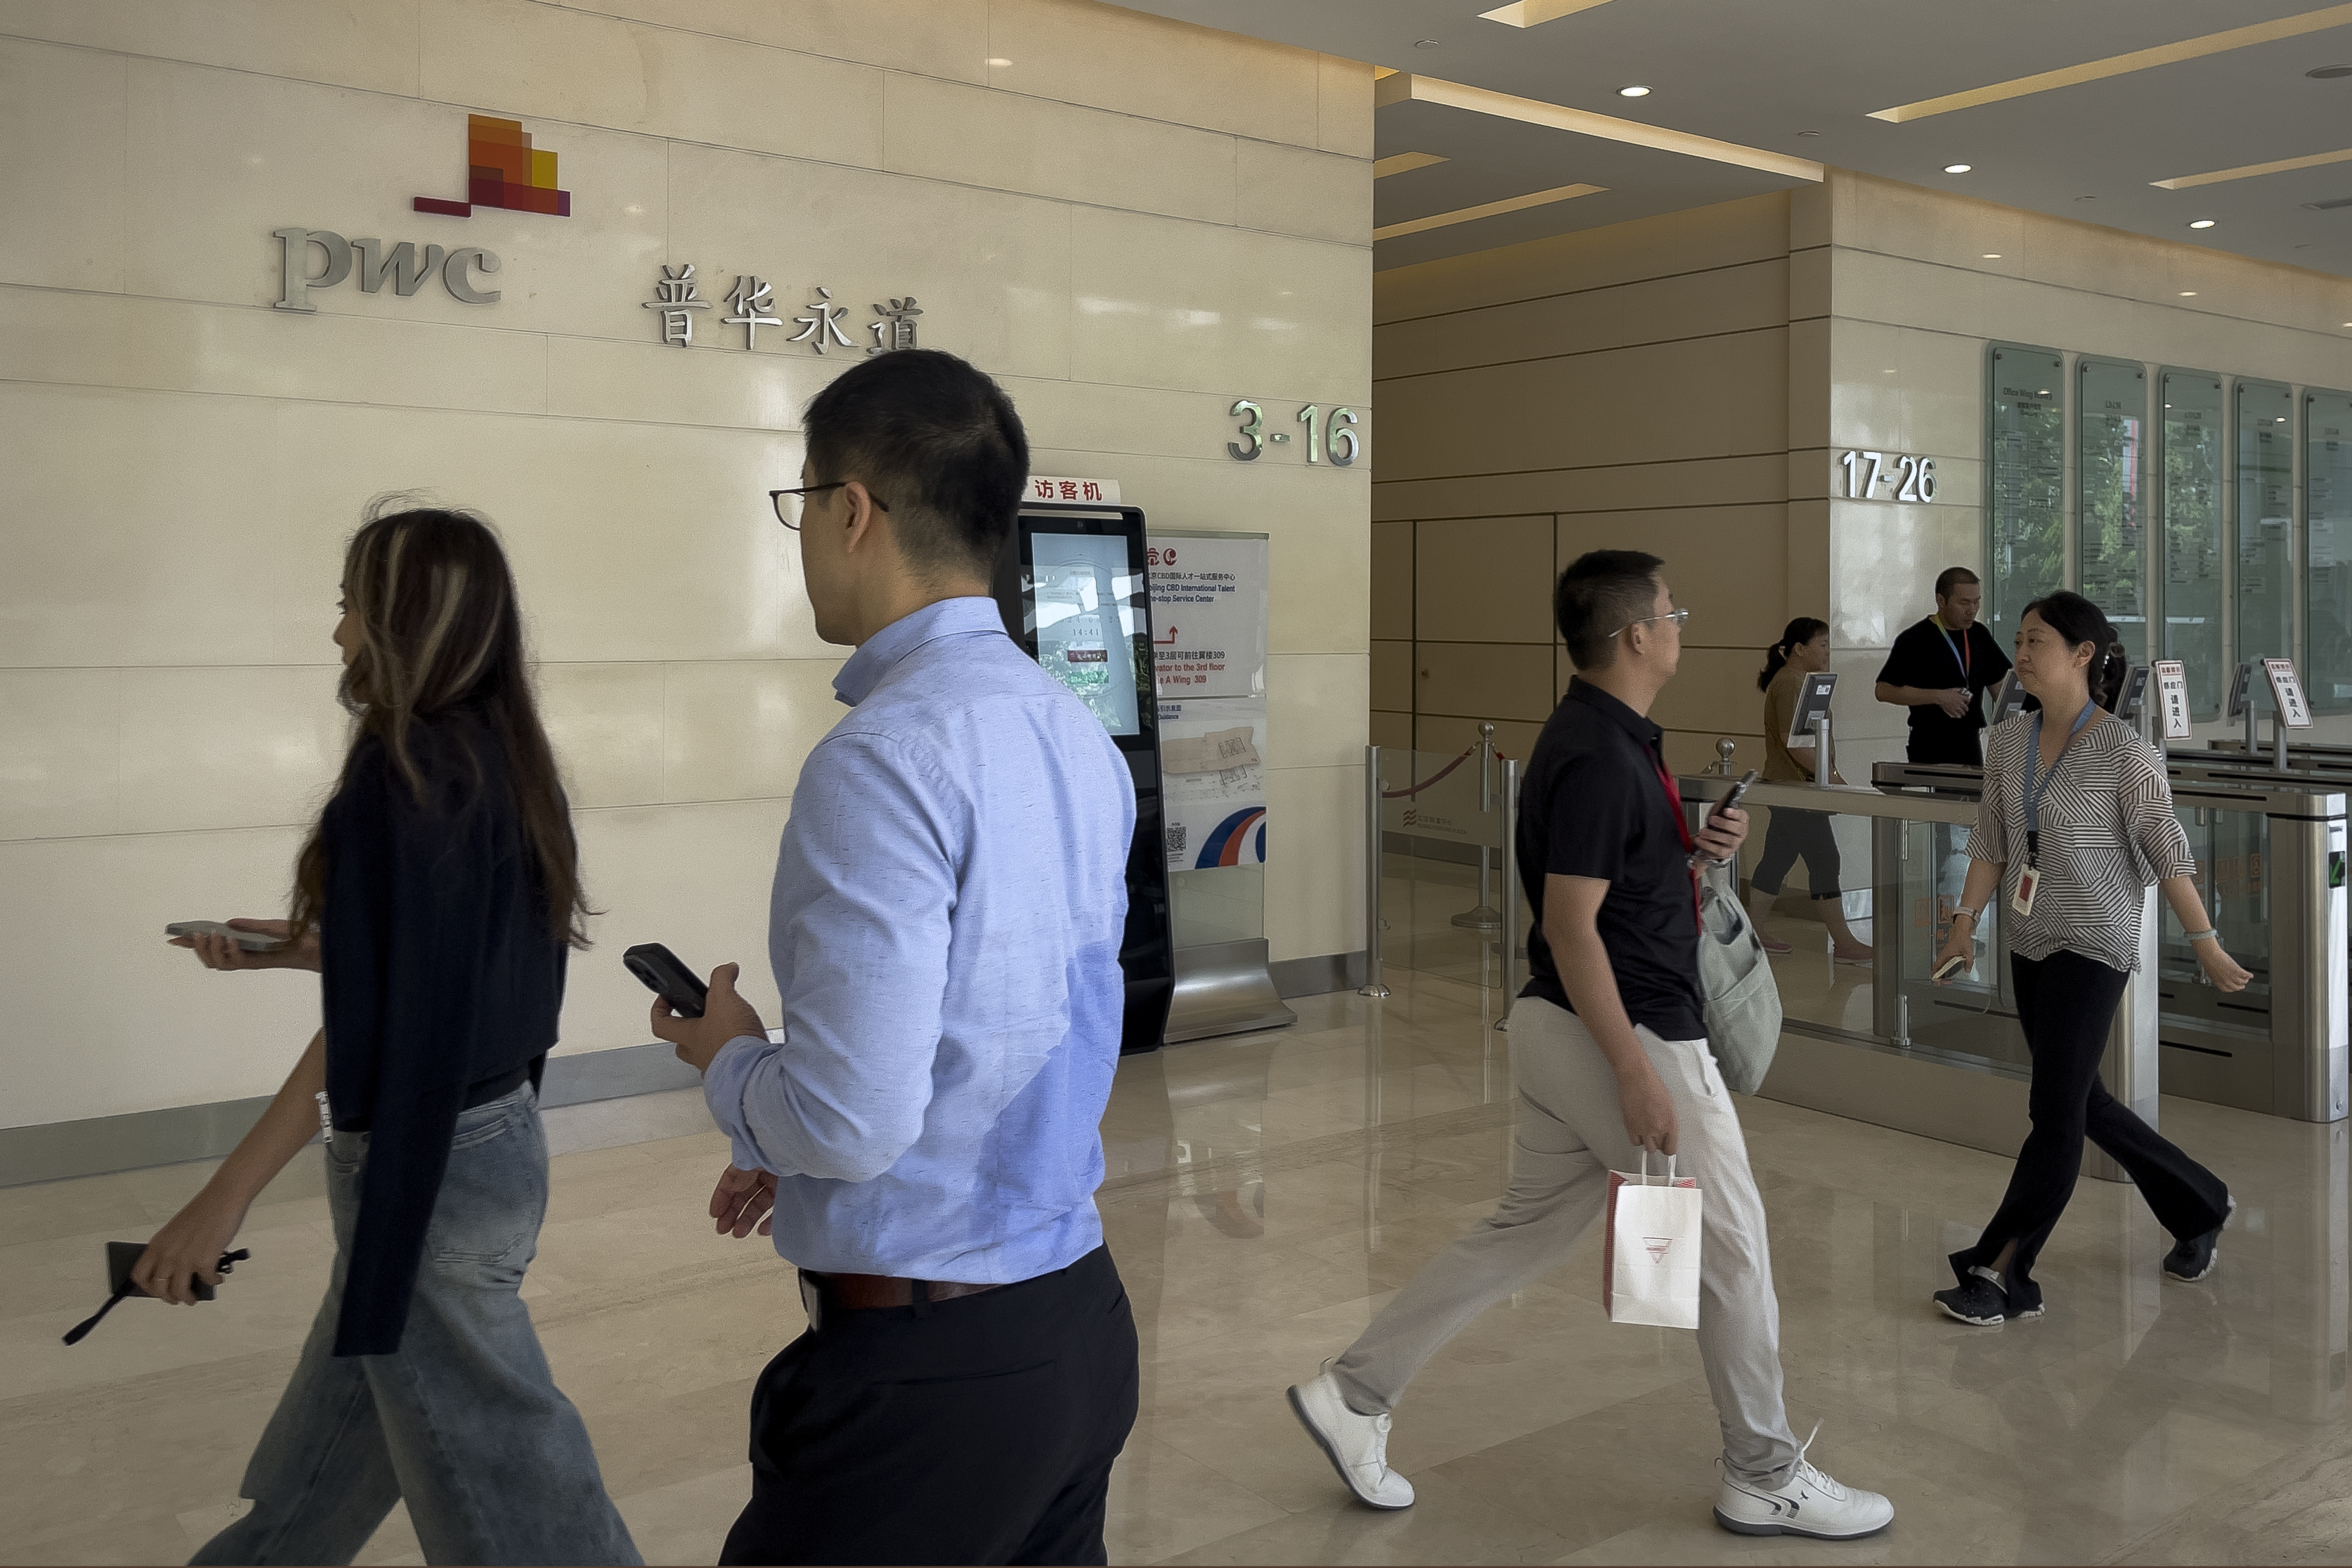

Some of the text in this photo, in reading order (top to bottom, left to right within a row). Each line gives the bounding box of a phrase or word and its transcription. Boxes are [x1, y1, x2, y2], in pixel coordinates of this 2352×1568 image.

[273, 227, 502, 312] pwc
[642, 264, 924, 355] 普华永道
[1228, 400, 1359, 466] 3-16
[1034, 479, 1102, 501] 访客机
[1839, 451, 1937, 503] 17-26
[1166, 675, 1171, 684] A
[1173, 675, 1191, 685] Wing
[1194, 675, 1207, 683] 309
[1196, 663, 1207, 671] 3rd
